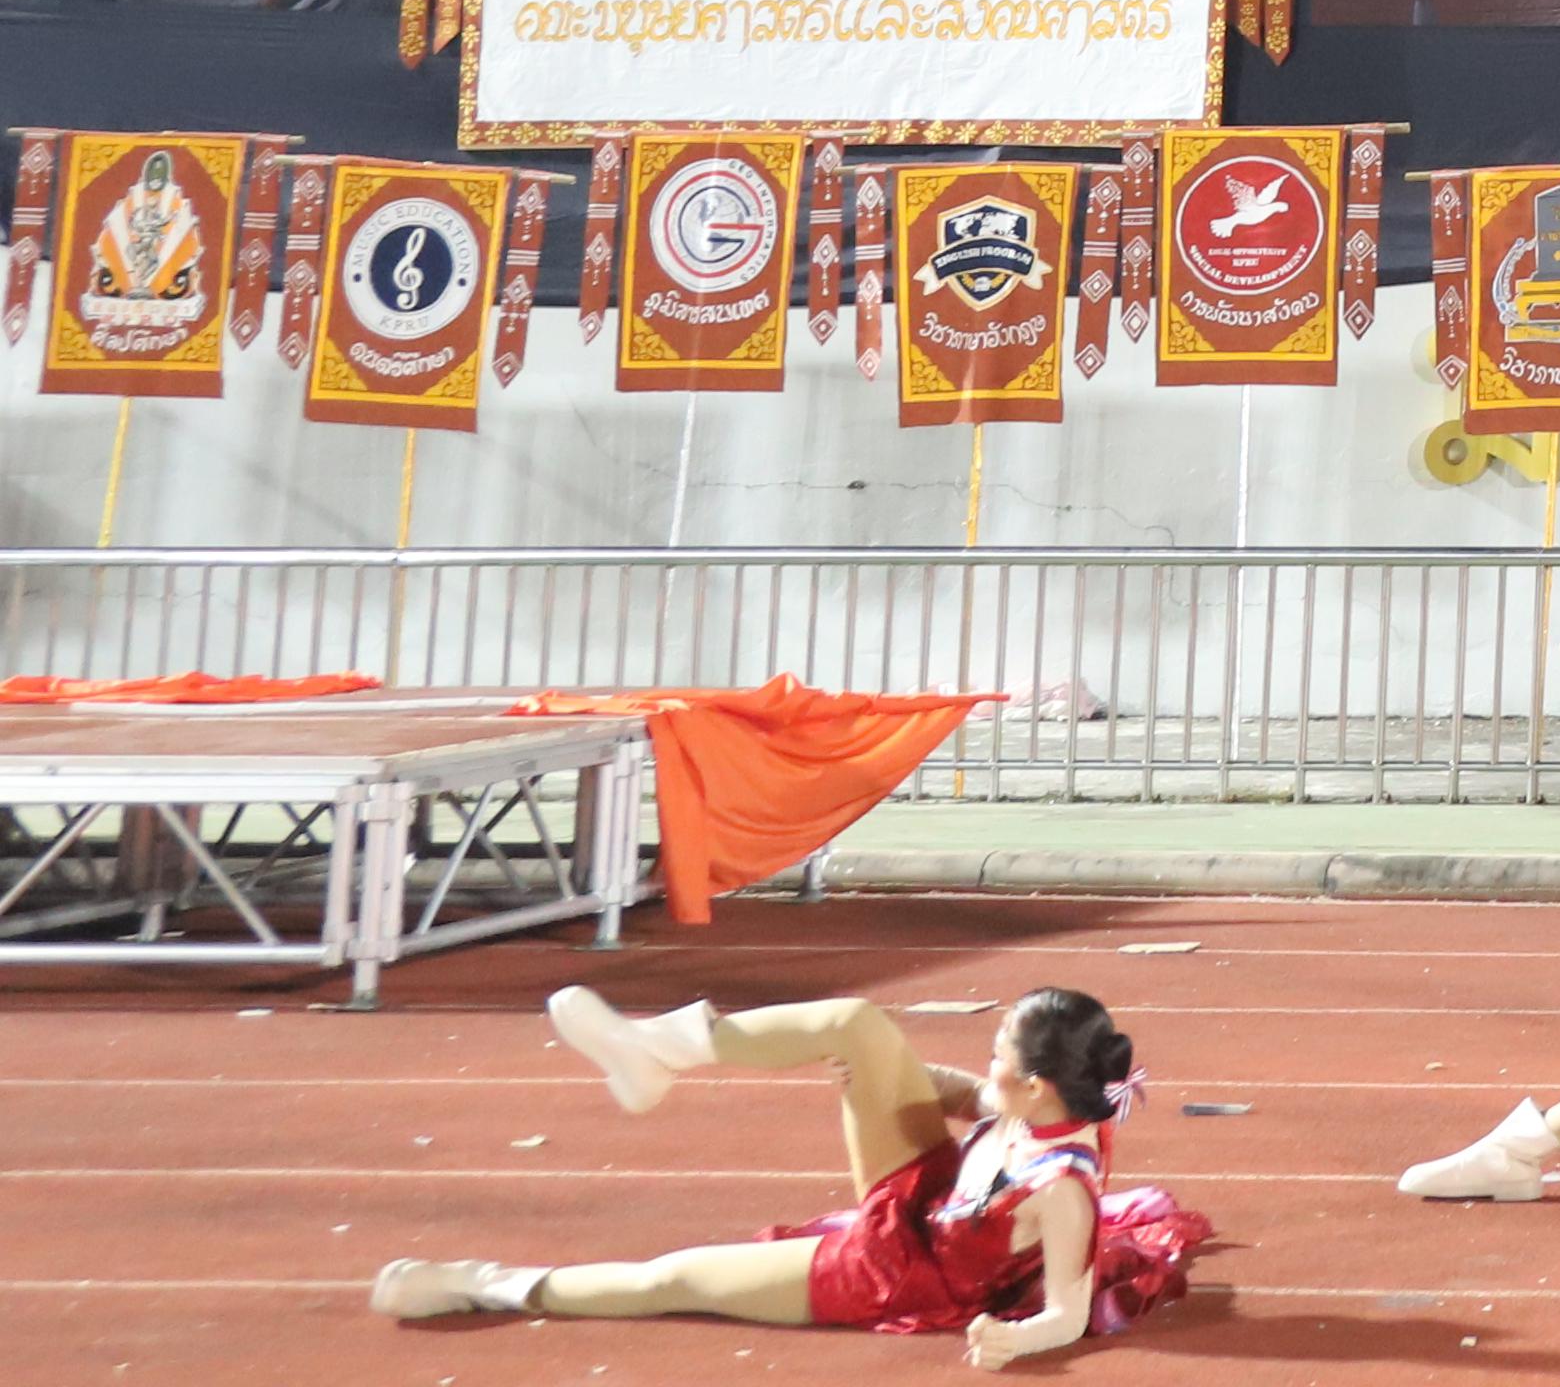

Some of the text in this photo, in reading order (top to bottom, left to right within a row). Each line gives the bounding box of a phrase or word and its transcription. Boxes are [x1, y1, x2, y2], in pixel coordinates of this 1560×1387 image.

[352, 205, 473, 275] MUSIC EDUCATION
[981, 245, 1033, 266] PROGRAM
[1189, 244, 1308, 285] SOCIAL DEVELOPMENT
[379, 315, 430, 331] KPRU
